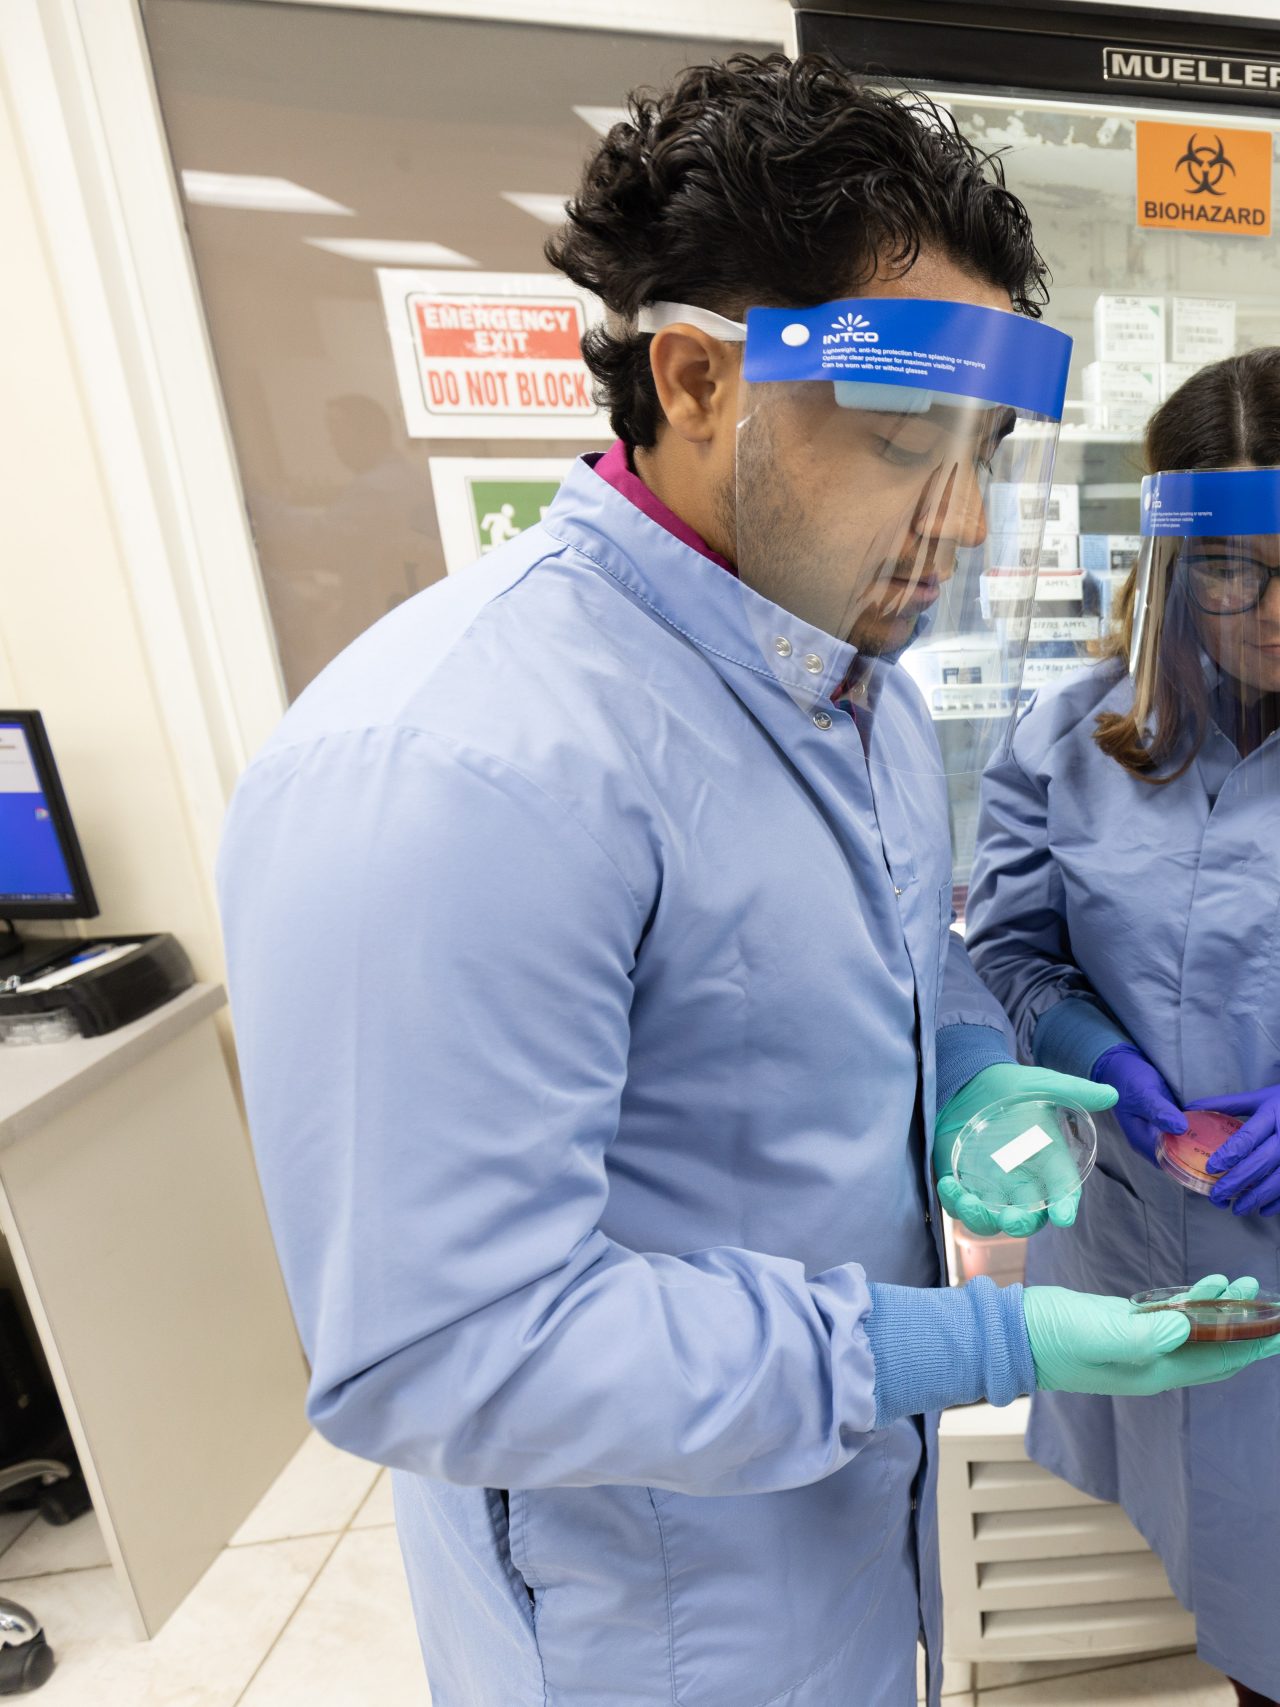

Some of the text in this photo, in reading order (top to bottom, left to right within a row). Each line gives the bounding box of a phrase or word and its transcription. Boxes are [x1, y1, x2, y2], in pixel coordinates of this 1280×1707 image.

[1144, 201, 1266, 226] BIOHAZARD
[423, 307, 572, 332] EMERGENCY
[473, 331, 528, 353] EXIT
[823, 331, 879, 345] INTCO
[858, 347, 882, 355] anti-fog
[883, 348, 912, 357] protection
[928, 353, 955, 364] splashing
[963, 359, 986, 370] spraying
[865, 355, 893, 363] polyester
[904, 358, 932, 367] maximum
[933, 362, 955, 372] visibility
[882, 364, 904, 372] without
[905, 367, 928, 376] glasses
[428, 370, 591, 408] DO NOT BLOCK
